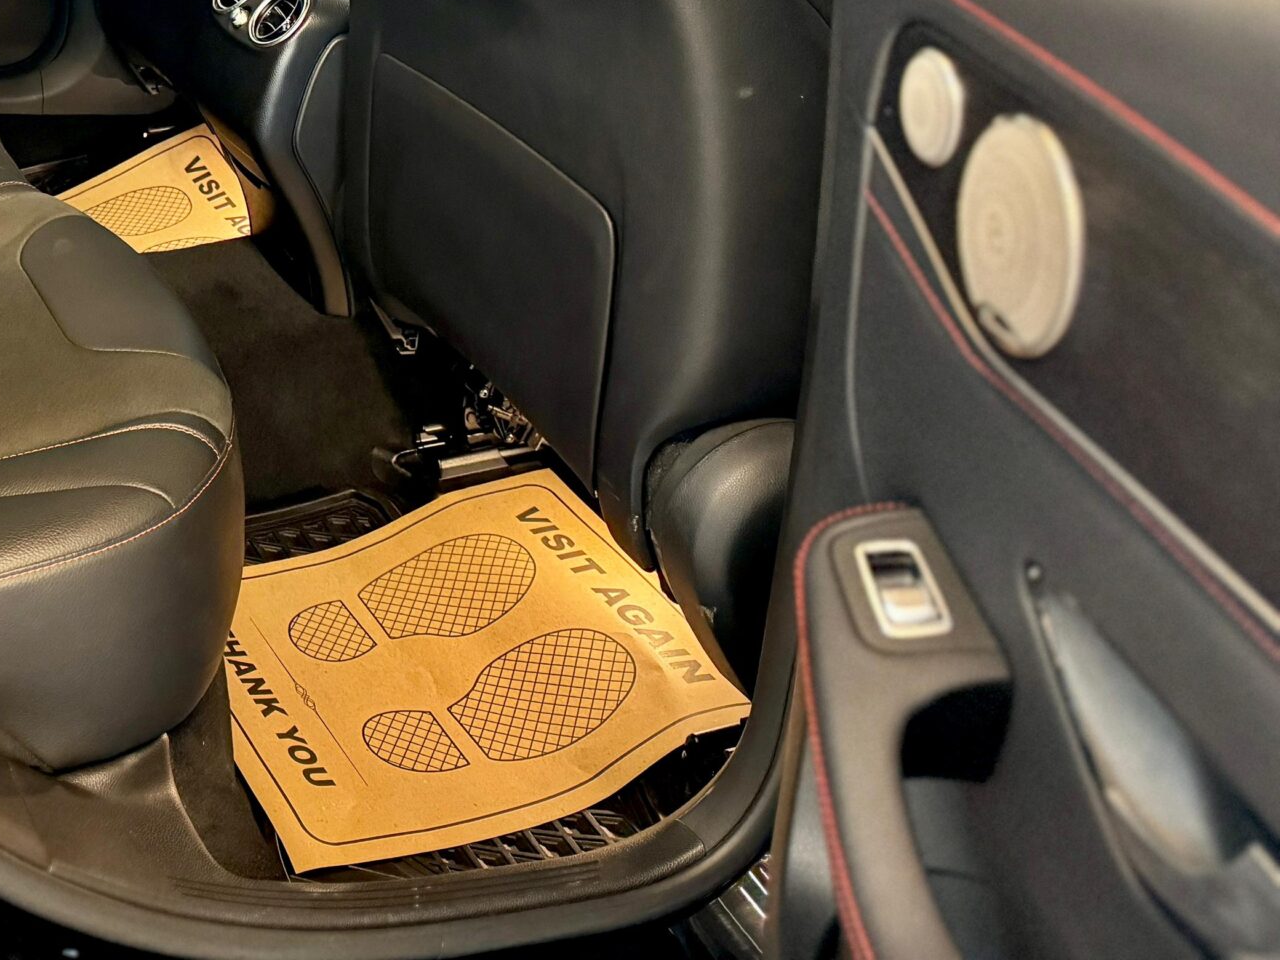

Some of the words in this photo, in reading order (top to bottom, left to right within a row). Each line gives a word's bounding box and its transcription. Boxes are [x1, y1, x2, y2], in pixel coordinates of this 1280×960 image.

[184, 155, 237, 210] VISIT
[516, 506, 608, 574] VISIT
[591, 587, 716, 684] AGAIN
[224, 630, 289, 718] HANK
[276, 725, 336, 786] YOU
